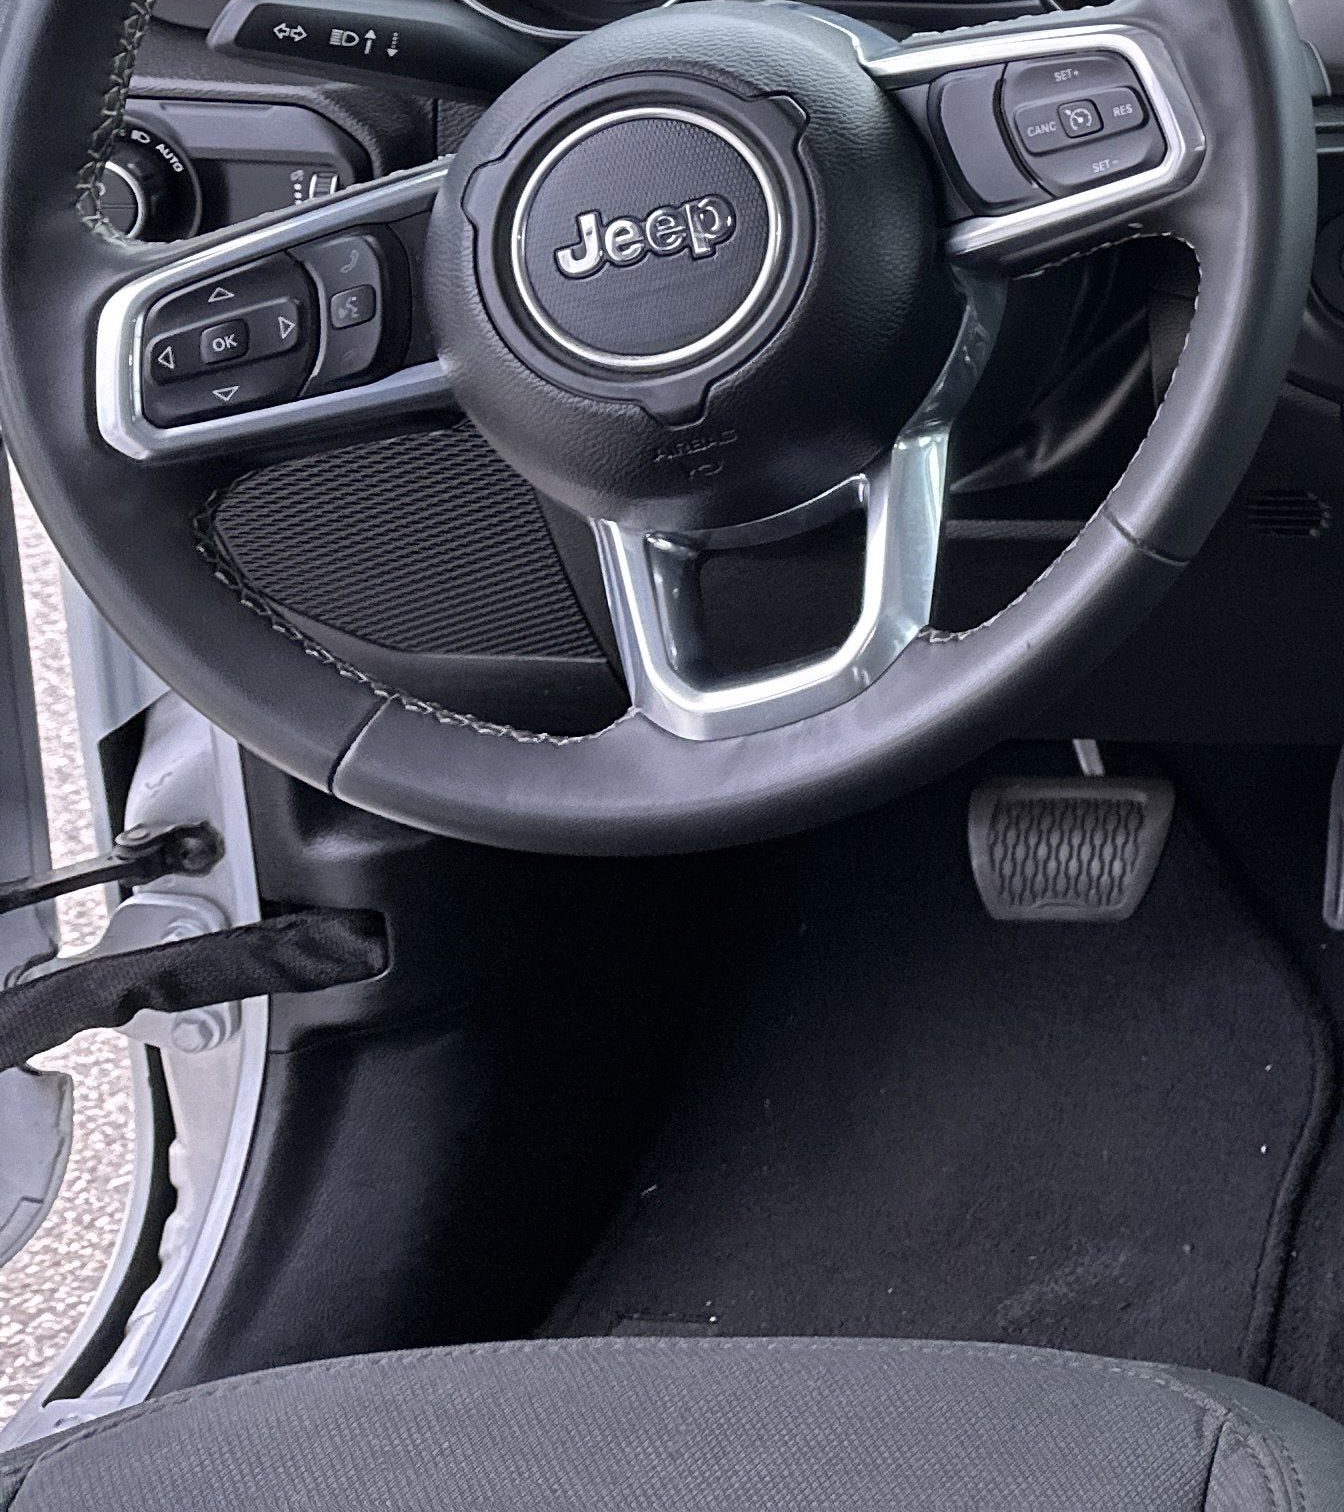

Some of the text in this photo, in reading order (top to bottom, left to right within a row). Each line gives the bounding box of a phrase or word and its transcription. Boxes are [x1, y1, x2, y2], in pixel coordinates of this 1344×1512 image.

[1113, 103, 1133, 117] RES
[1027, 121, 1057, 138] CANC
[155, 143, 185, 173] AUTO
[554, 194, 736, 280] Jeep
[212, 333, 237, 351] OK
